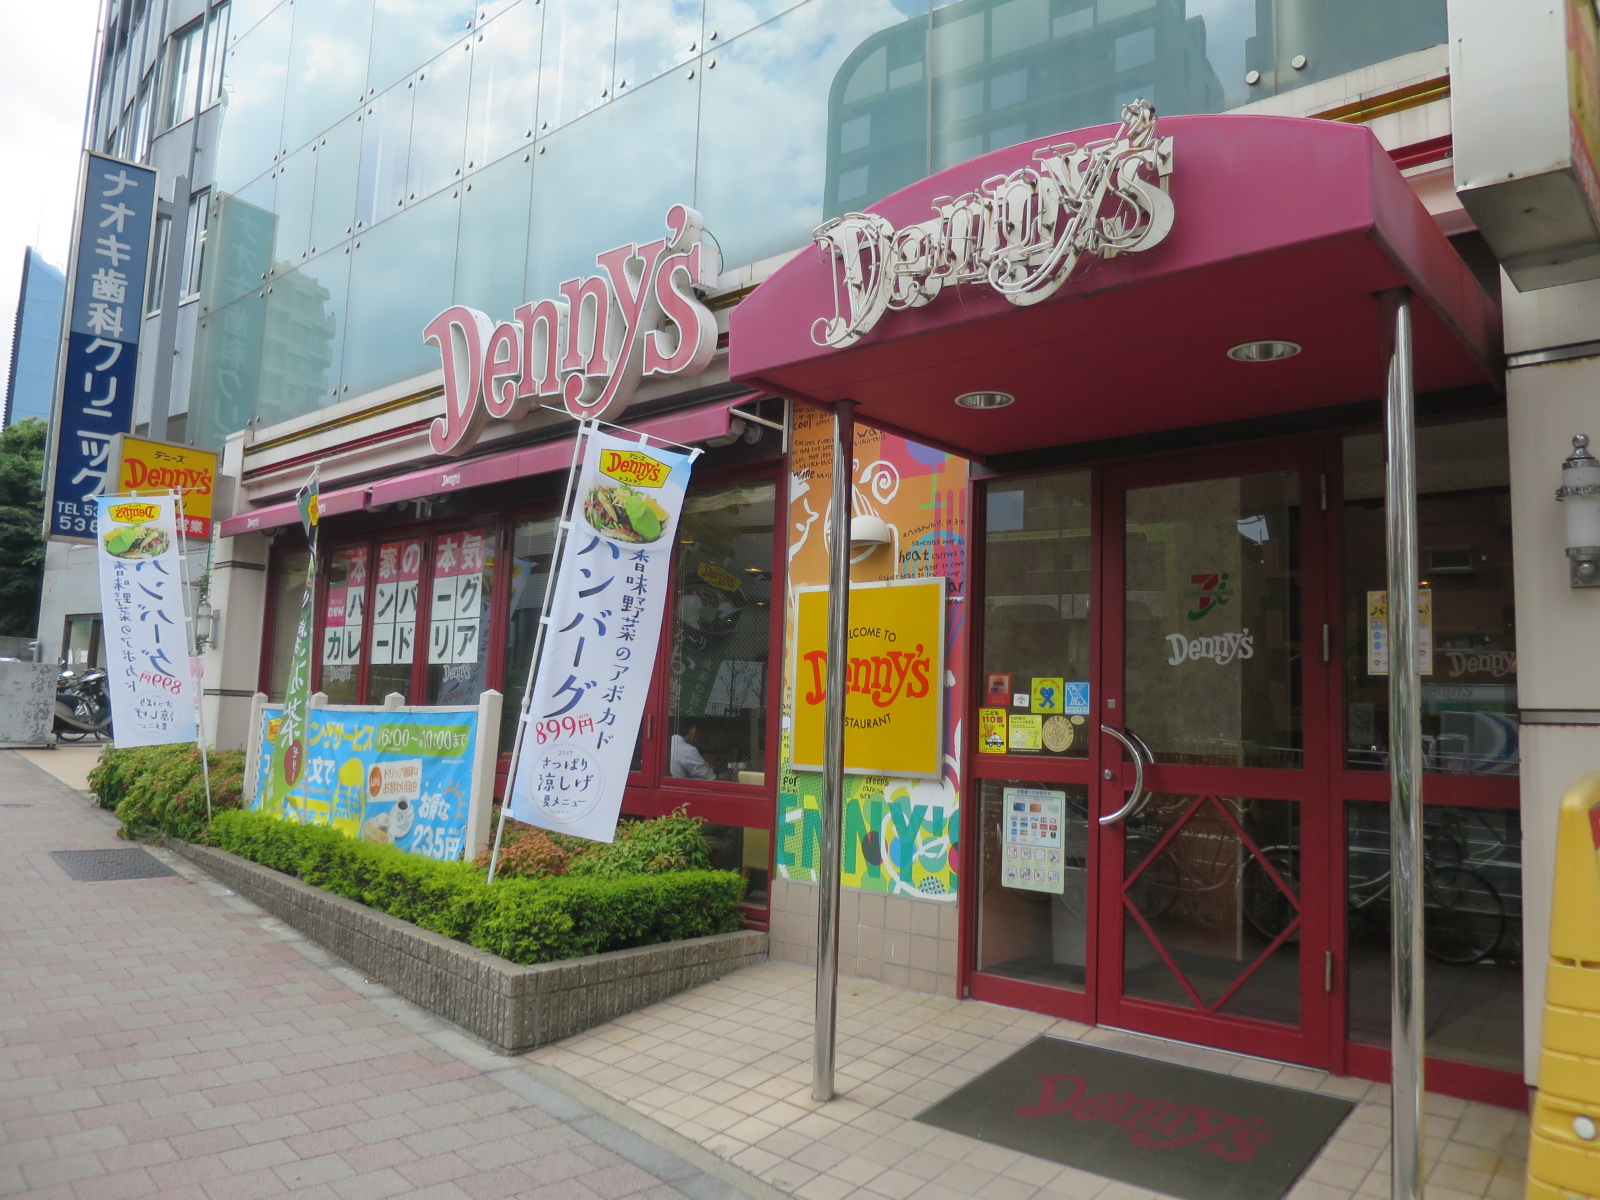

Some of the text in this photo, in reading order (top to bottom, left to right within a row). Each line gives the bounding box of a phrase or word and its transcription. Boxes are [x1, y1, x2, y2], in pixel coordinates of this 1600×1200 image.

[811, 99, 1176, 349] Denny's
[71, 170, 138, 502] ナオキ歯科クリニック
[423, 204, 718, 456] Denny's
[154, 451, 187, 464] デニーズ
[606, 453, 661, 482] Denny's
[123, 458, 212, 496] Denny's
[57, 501, 80, 516] TEL
[351, 535, 483, 583] 本家の本気
[899, 549, 930, 563] heat
[327, 605, 345, 618] new
[347, 577, 480, 619] ハンバーグ
[326, 624, 477, 660] カレードリア
[543, 536, 620, 719] ハンバーグ
[846, 627, 897, 643] LCOME TO
[596, 549, 650, 750] 香味野菜のアボカド
[1165, 627, 1254, 666] Denny's
[535, 716, 594, 745] 899円
[844, 712, 892, 729] STAURANT
[542, 757, 588, 771] さっぱり
[538, 773, 594, 792] 涼しげ
[418, 791, 451, 821] お得な
[542, 794, 587, 807] 夏メニュー
[410, 823, 461, 861] 235円
[1015, 1073, 1272, 1162] Denny's
